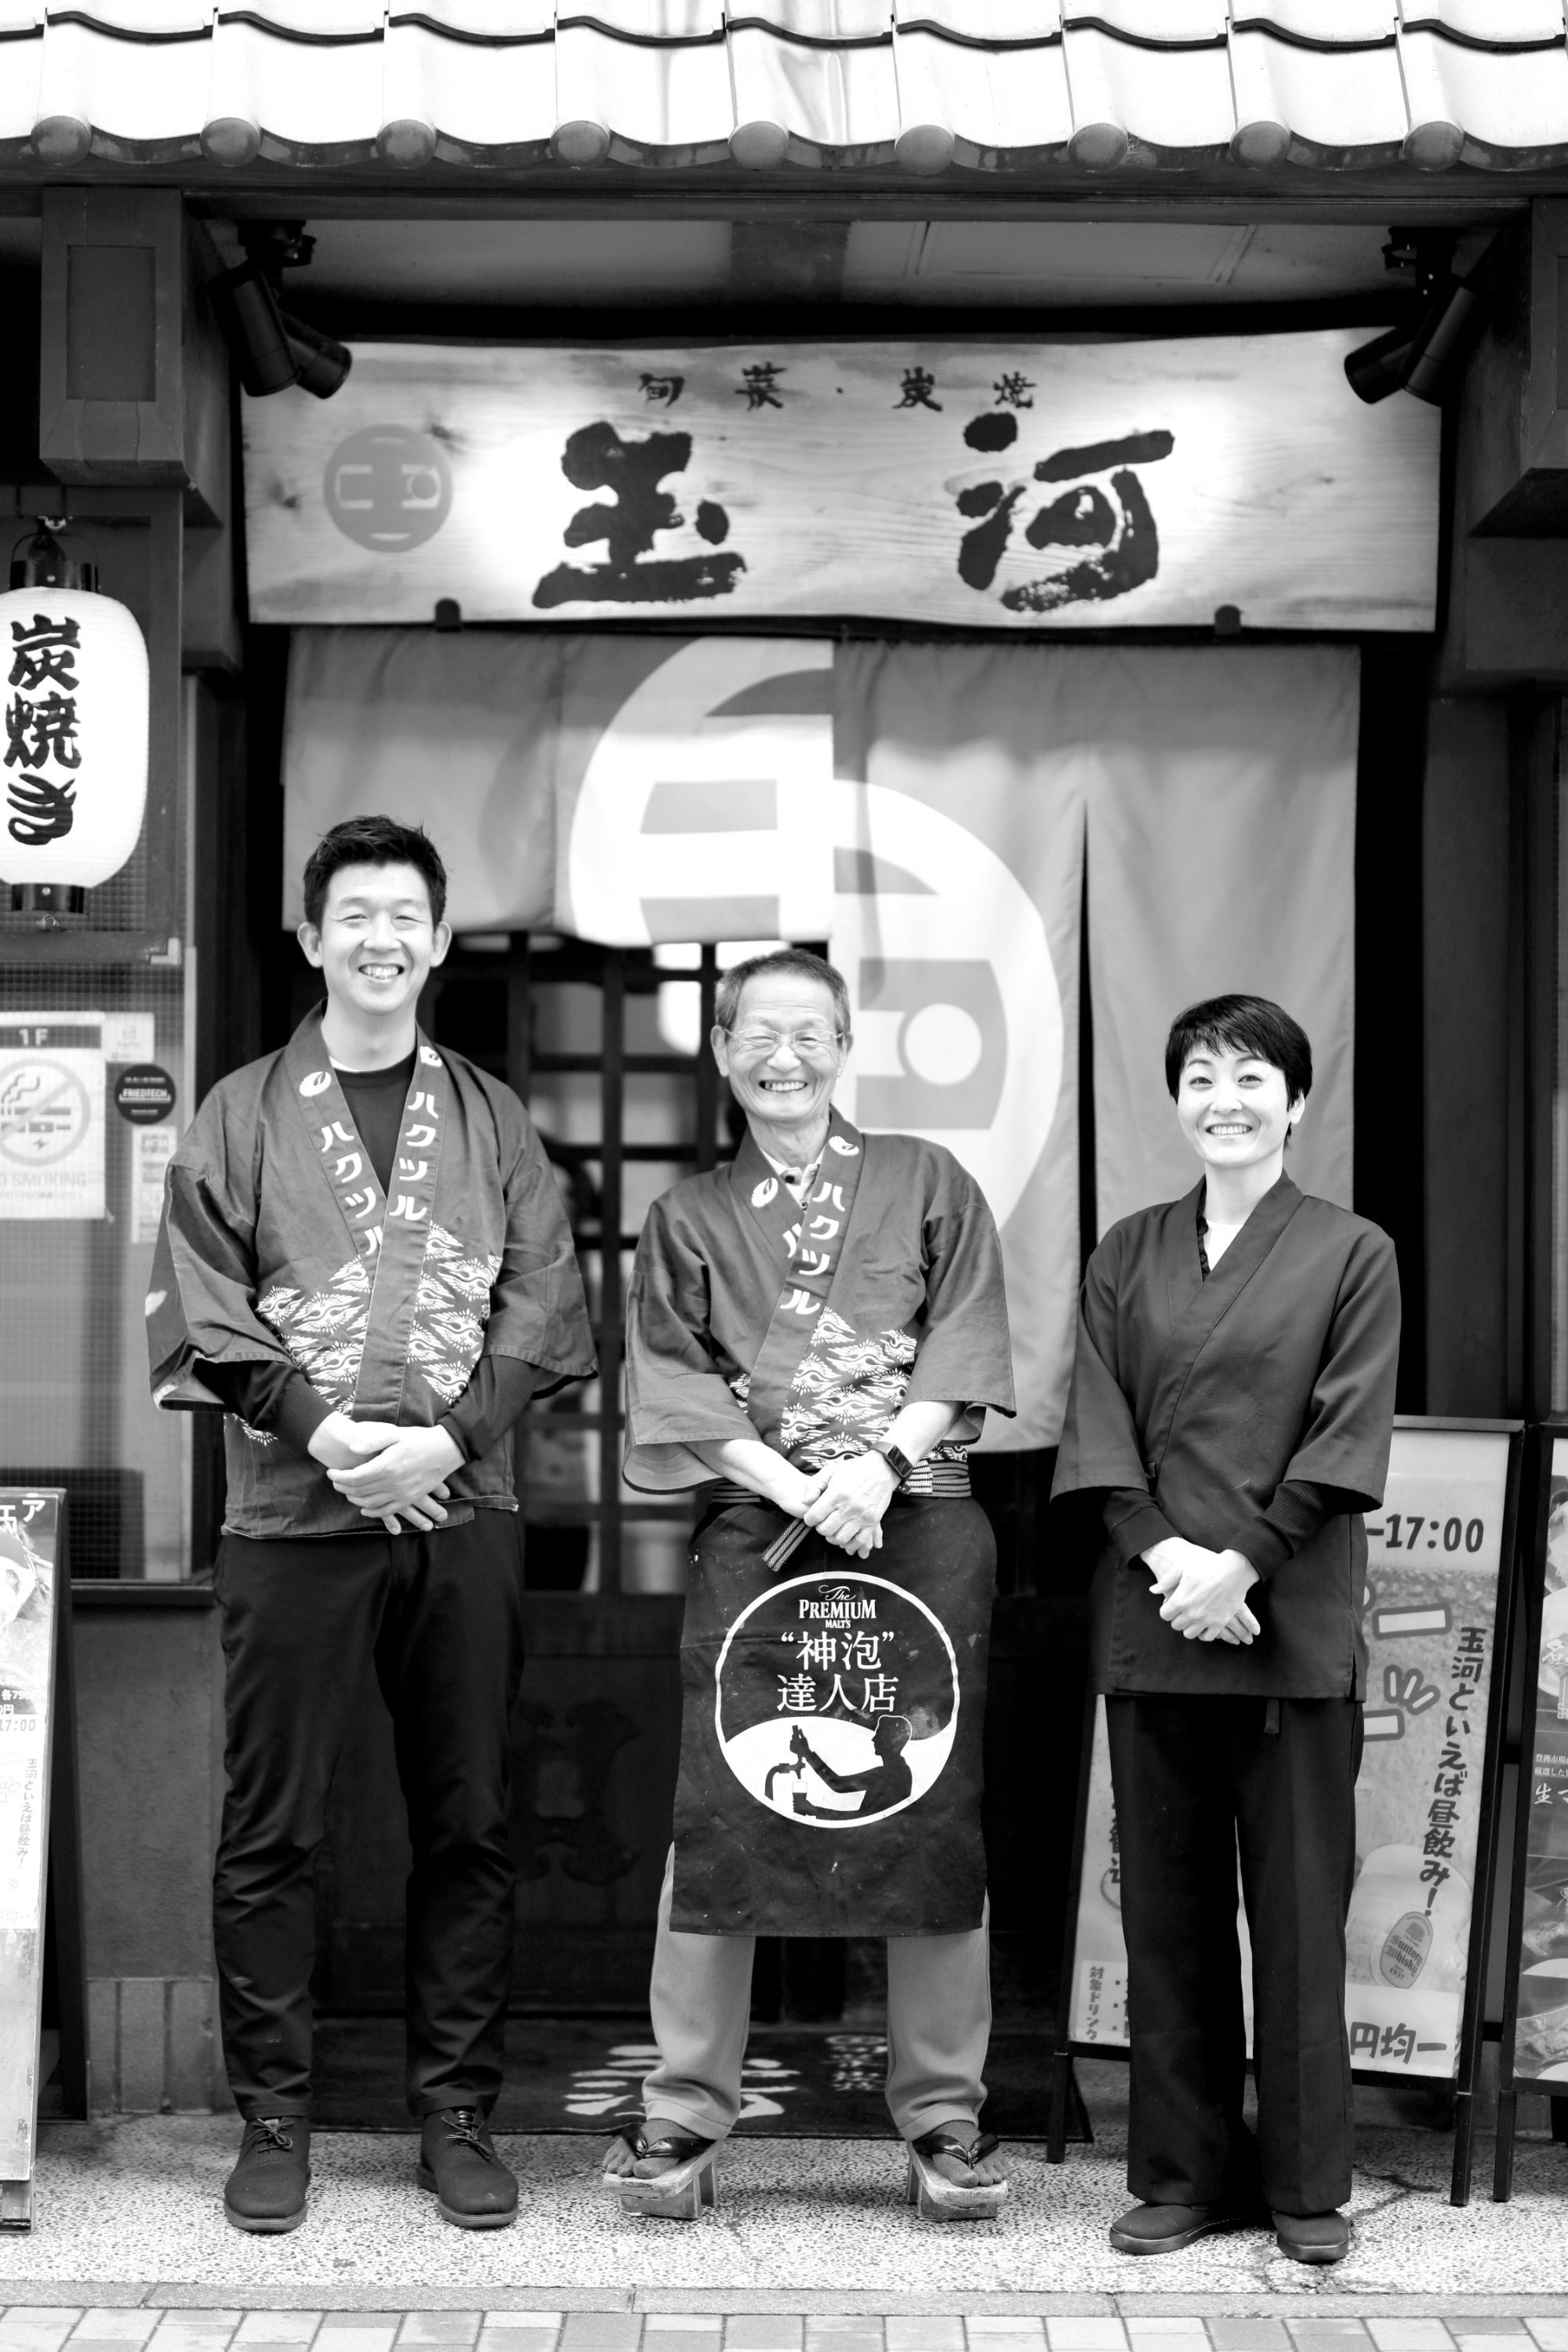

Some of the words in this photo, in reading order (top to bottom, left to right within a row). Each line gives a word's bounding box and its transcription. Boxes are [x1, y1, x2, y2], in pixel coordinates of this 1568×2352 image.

[3, 613, 82, 846] 炭焼き
[389, 1091, 439, 1222] ハクツル
[12, 1172, 86, 1187] SMOKING
[779, 1181, 847, 1316] ハクツル
[798, 1599, 877, 1619] PREMIUM
[818, 1584, 856, 1601] The
[825, 1618, 851, 1629] MALT'S
[776, 1672, 899, 1713] 達人店
[1385, 1944, 1418, 1978] Whisky
[1389, 1934, 1424, 1967] Suntory
[1388, 1966, 1406, 1980] 1937
